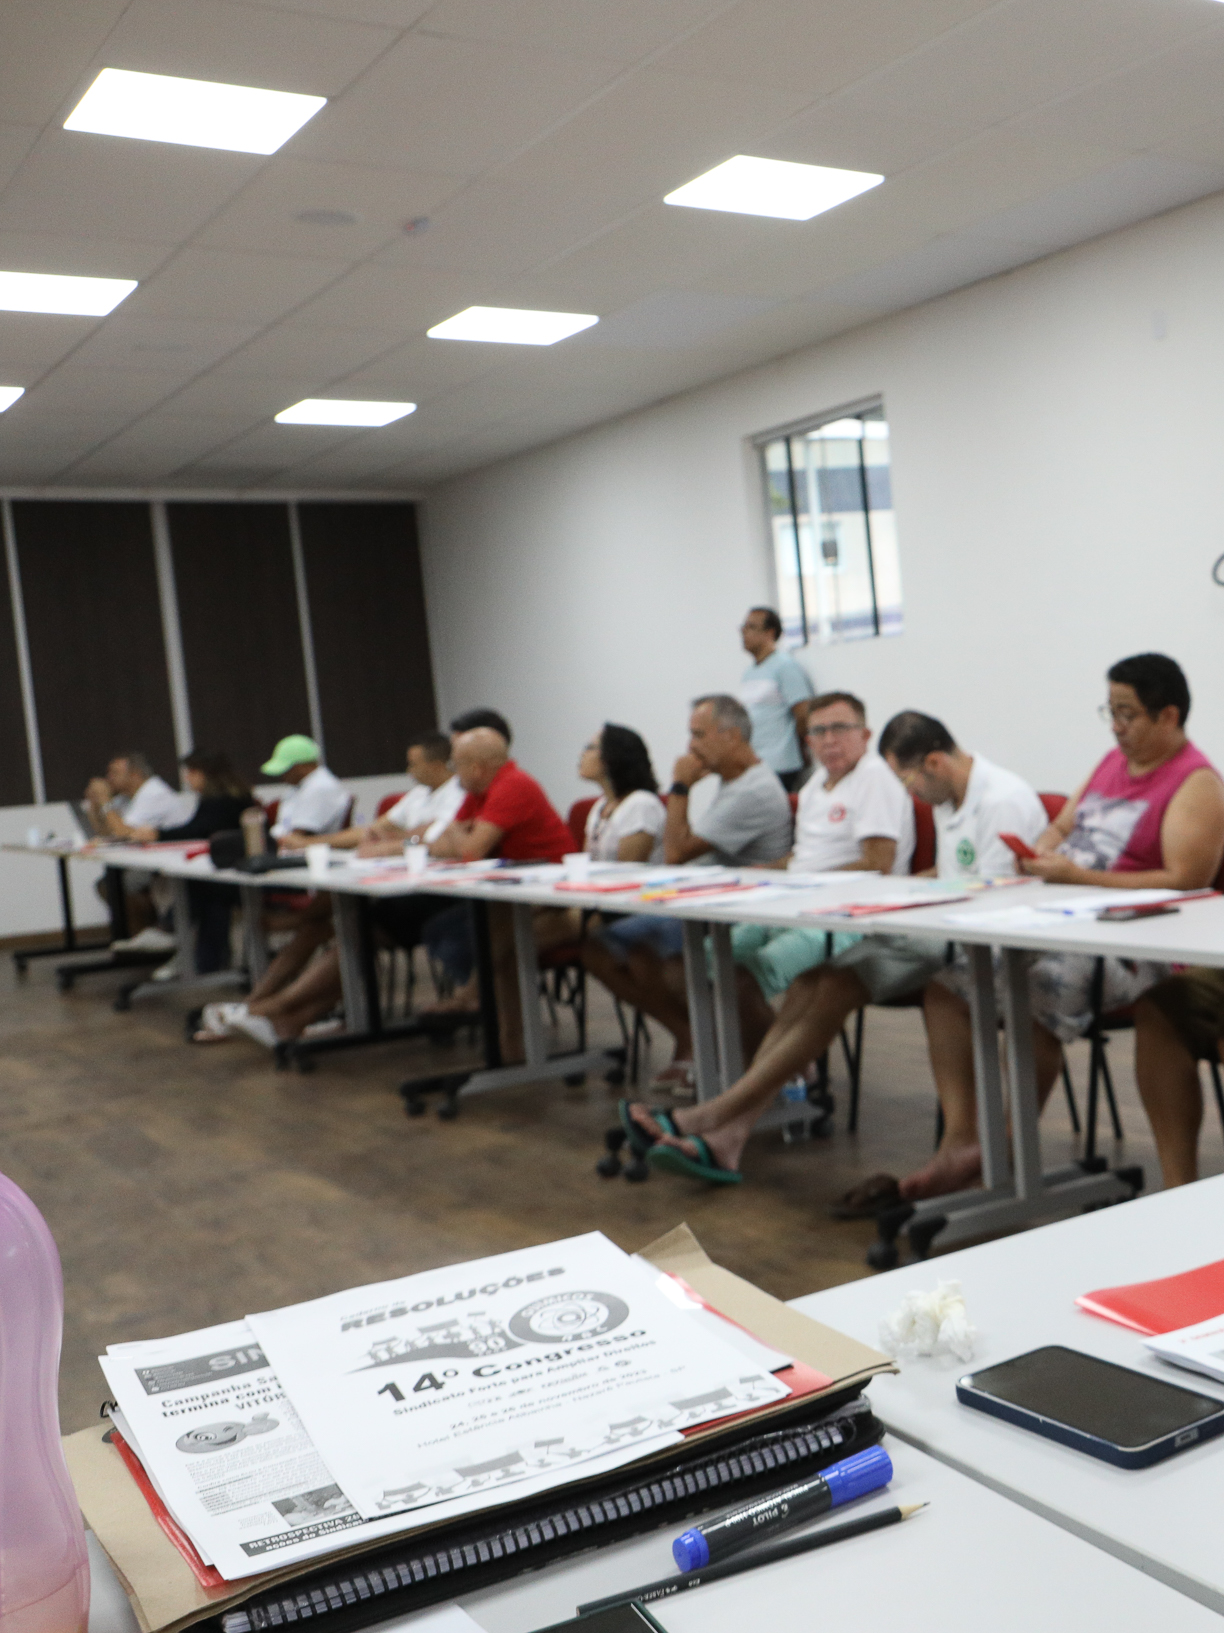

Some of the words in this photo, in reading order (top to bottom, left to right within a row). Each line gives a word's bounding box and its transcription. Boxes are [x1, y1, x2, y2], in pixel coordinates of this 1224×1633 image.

[341, 1266, 566, 1332] RESOLUÇÕES
[472, 1330, 646, 1378] Congresso
[393, 1391, 466, 1415] Sindicato
[469, 1380, 507, 1394] Forte
[511, 1371, 543, 1384] para
[547, 1355, 600, 1373] Ampliar
[603, 1340, 657, 1357] Direitos
[161, 1383, 252, 1408] Campanha
[161, 1397, 230, 1418] termina
[236, 1386, 271, 1400] com
[753, 1507, 779, 1527] PILOT
[248, 1519, 343, 1549] RETROSPECTIVA
[302, 1532, 316, 1541] do
